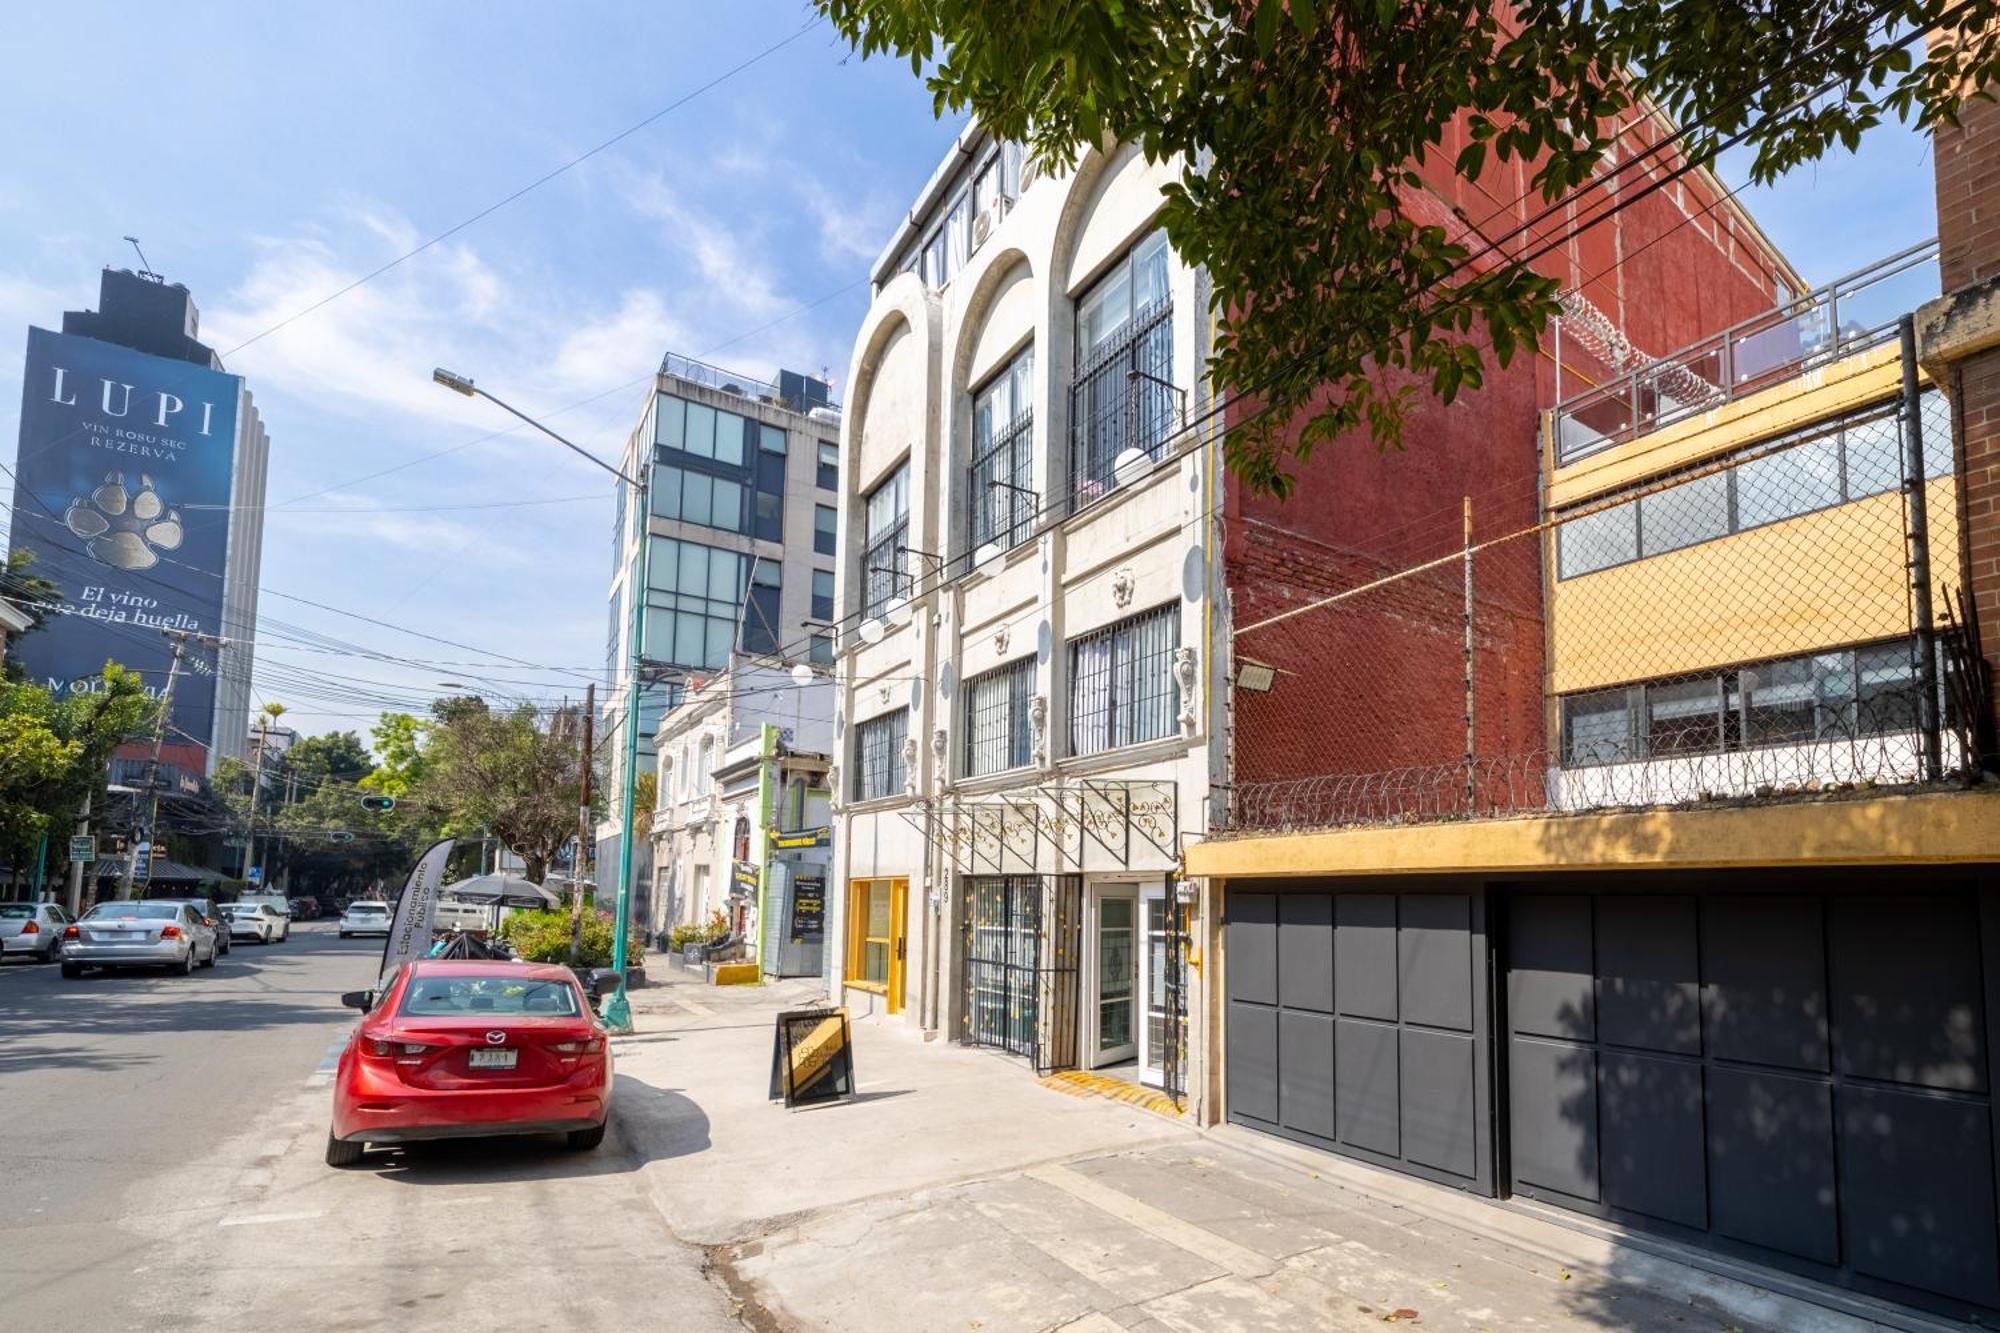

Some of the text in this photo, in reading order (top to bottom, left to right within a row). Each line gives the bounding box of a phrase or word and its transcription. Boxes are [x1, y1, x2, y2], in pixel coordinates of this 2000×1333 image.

[50, 366, 215, 437] LUPI
[82, 421, 109, 435] VIN
[161, 438, 188, 450] SEC
[91, 436, 177, 462] REZERVA
[80, 586, 158, 609] El vino
[80, 603, 126, 623] deja
[133, 608, 199, 631] huella
